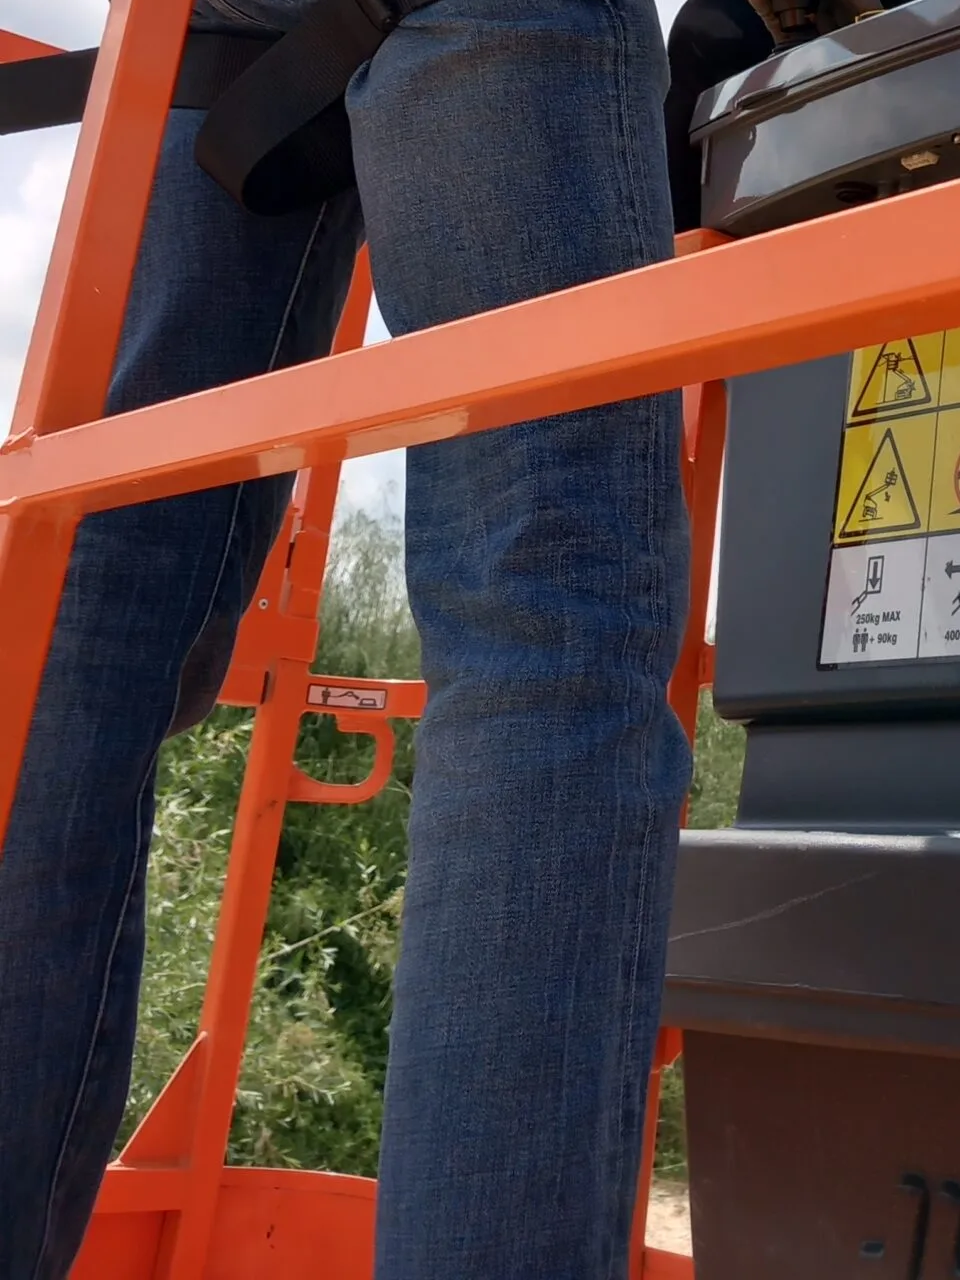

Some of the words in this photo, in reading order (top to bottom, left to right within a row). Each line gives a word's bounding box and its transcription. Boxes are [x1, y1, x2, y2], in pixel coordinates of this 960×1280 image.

[856, 613, 881, 626] 250kg
[882, 611, 901, 623] MAX
[877, 632, 898, 645] 90kg
